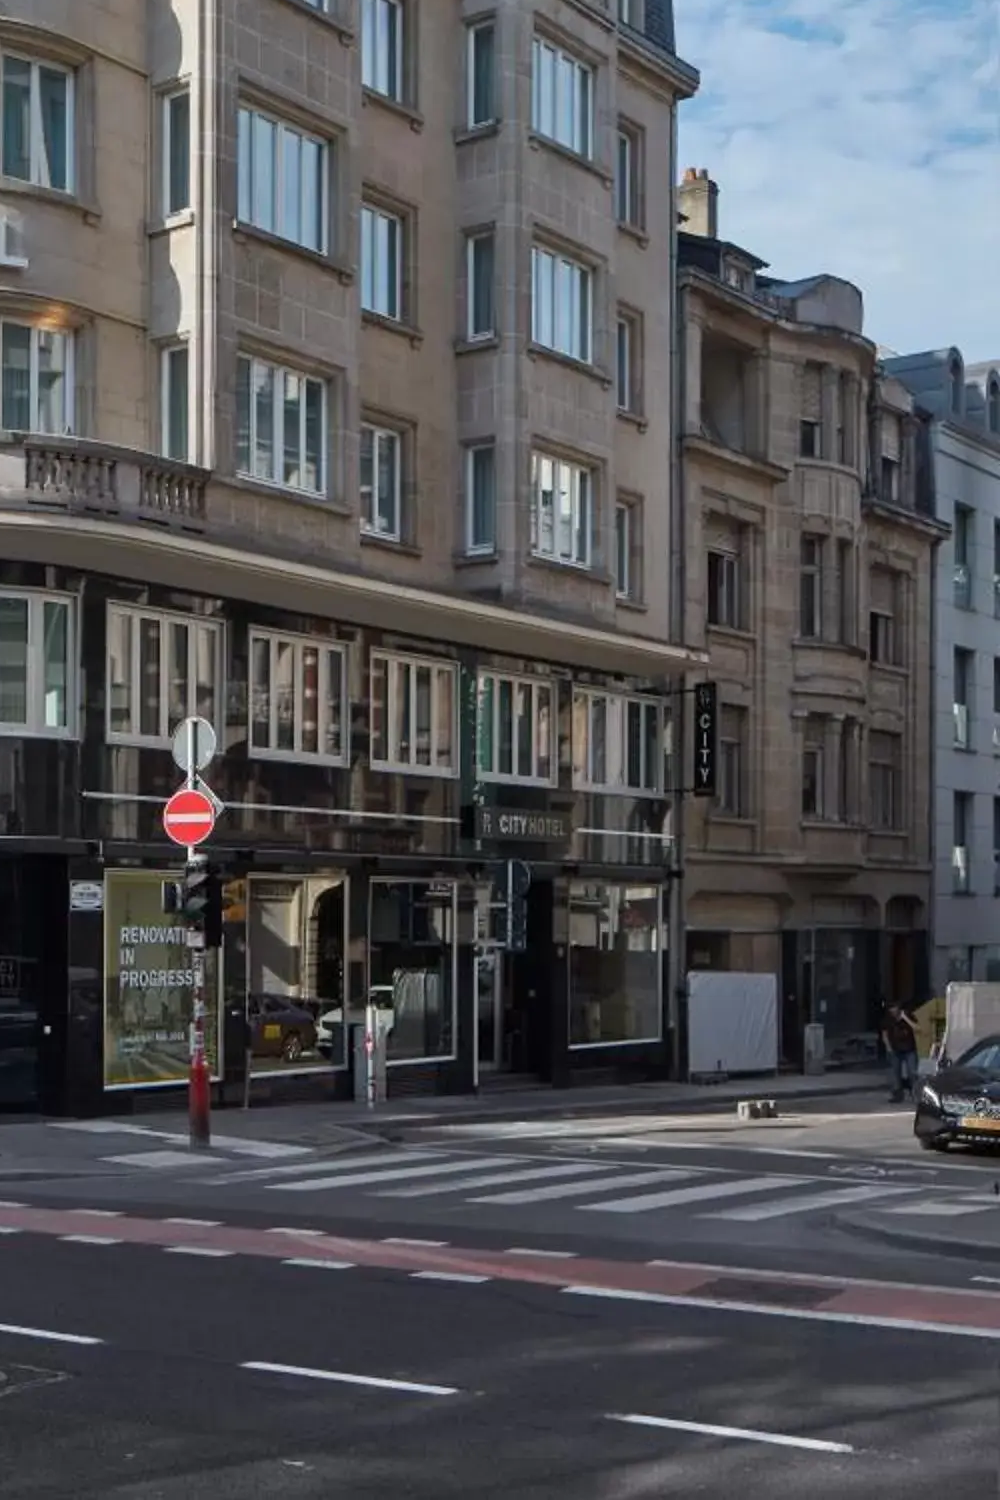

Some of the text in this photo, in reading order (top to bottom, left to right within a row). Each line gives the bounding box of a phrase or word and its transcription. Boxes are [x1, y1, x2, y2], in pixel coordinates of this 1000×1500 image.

[699, 713, 711, 784] CITY
[121, 927, 187, 944] RENOVATI
[120, 948, 135, 965] IN
[120, 970, 193, 988] PROGRESS
